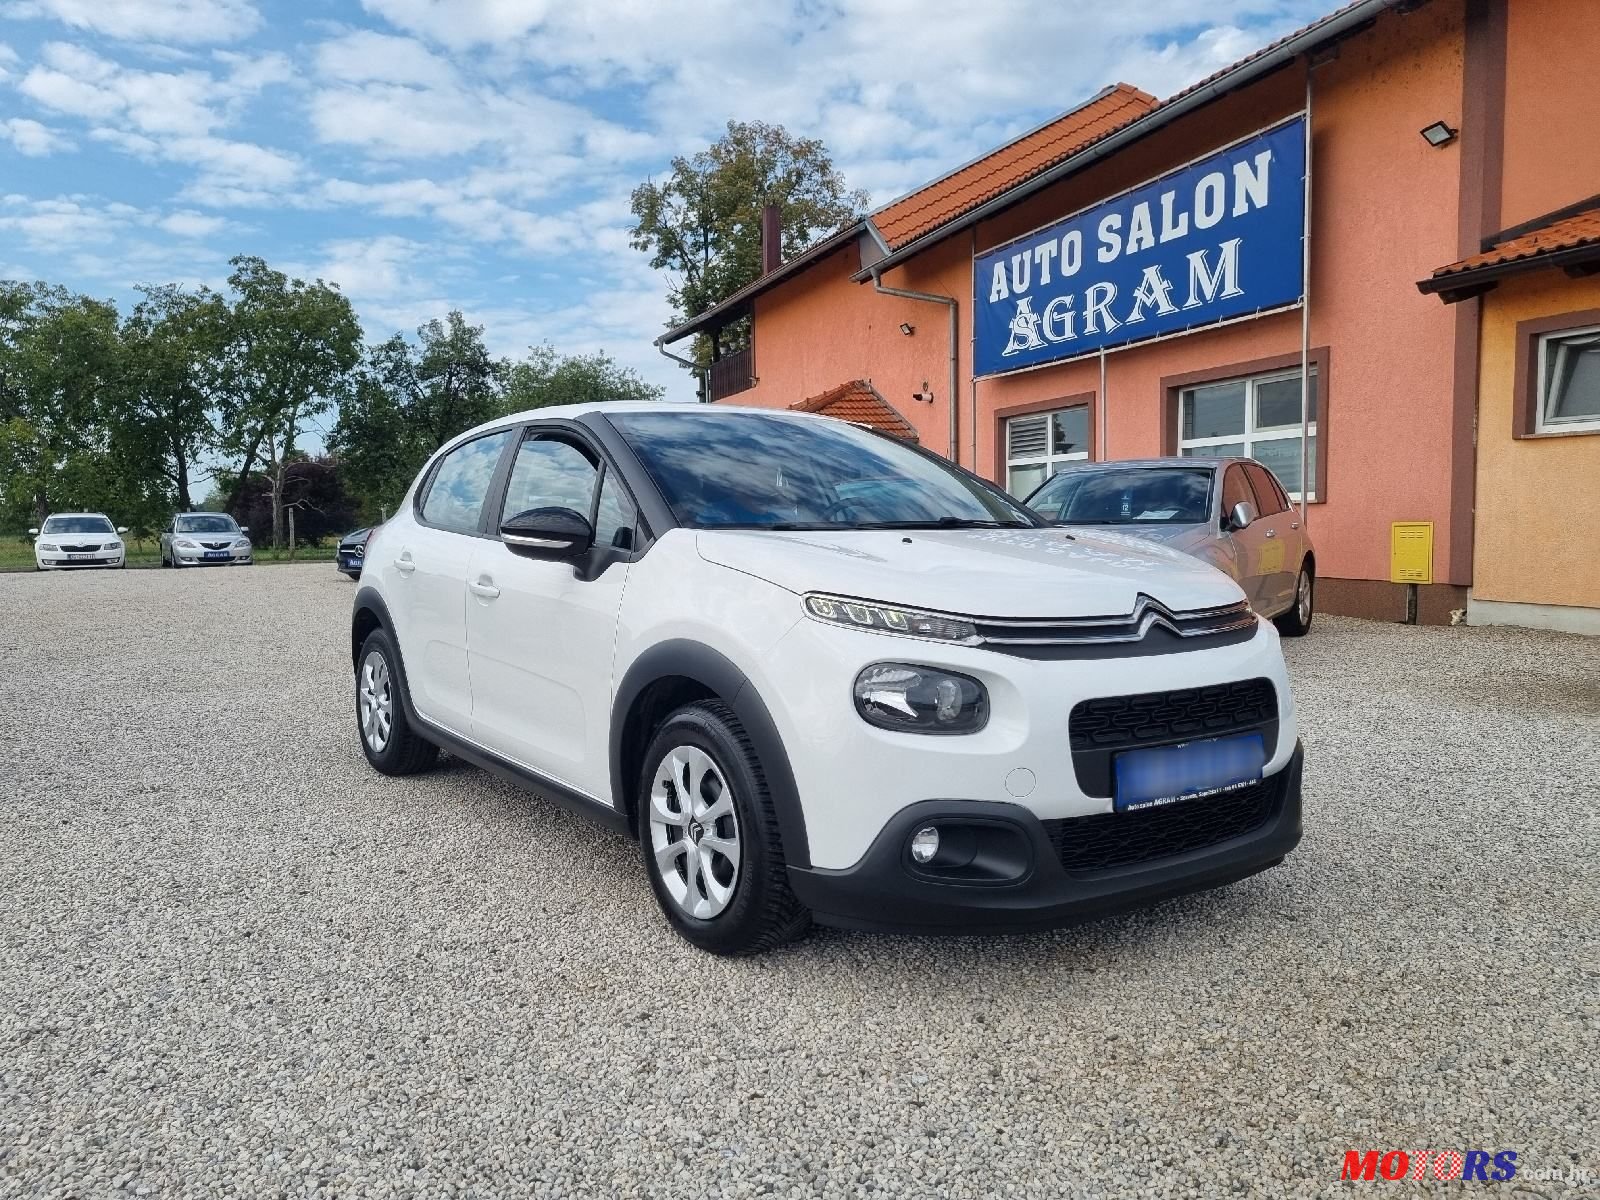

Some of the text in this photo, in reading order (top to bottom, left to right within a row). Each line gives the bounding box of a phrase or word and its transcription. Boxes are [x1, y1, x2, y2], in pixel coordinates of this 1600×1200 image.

[989, 149, 1272, 304] AUTO SALON
[1002, 237, 1245, 357] AGRAM
